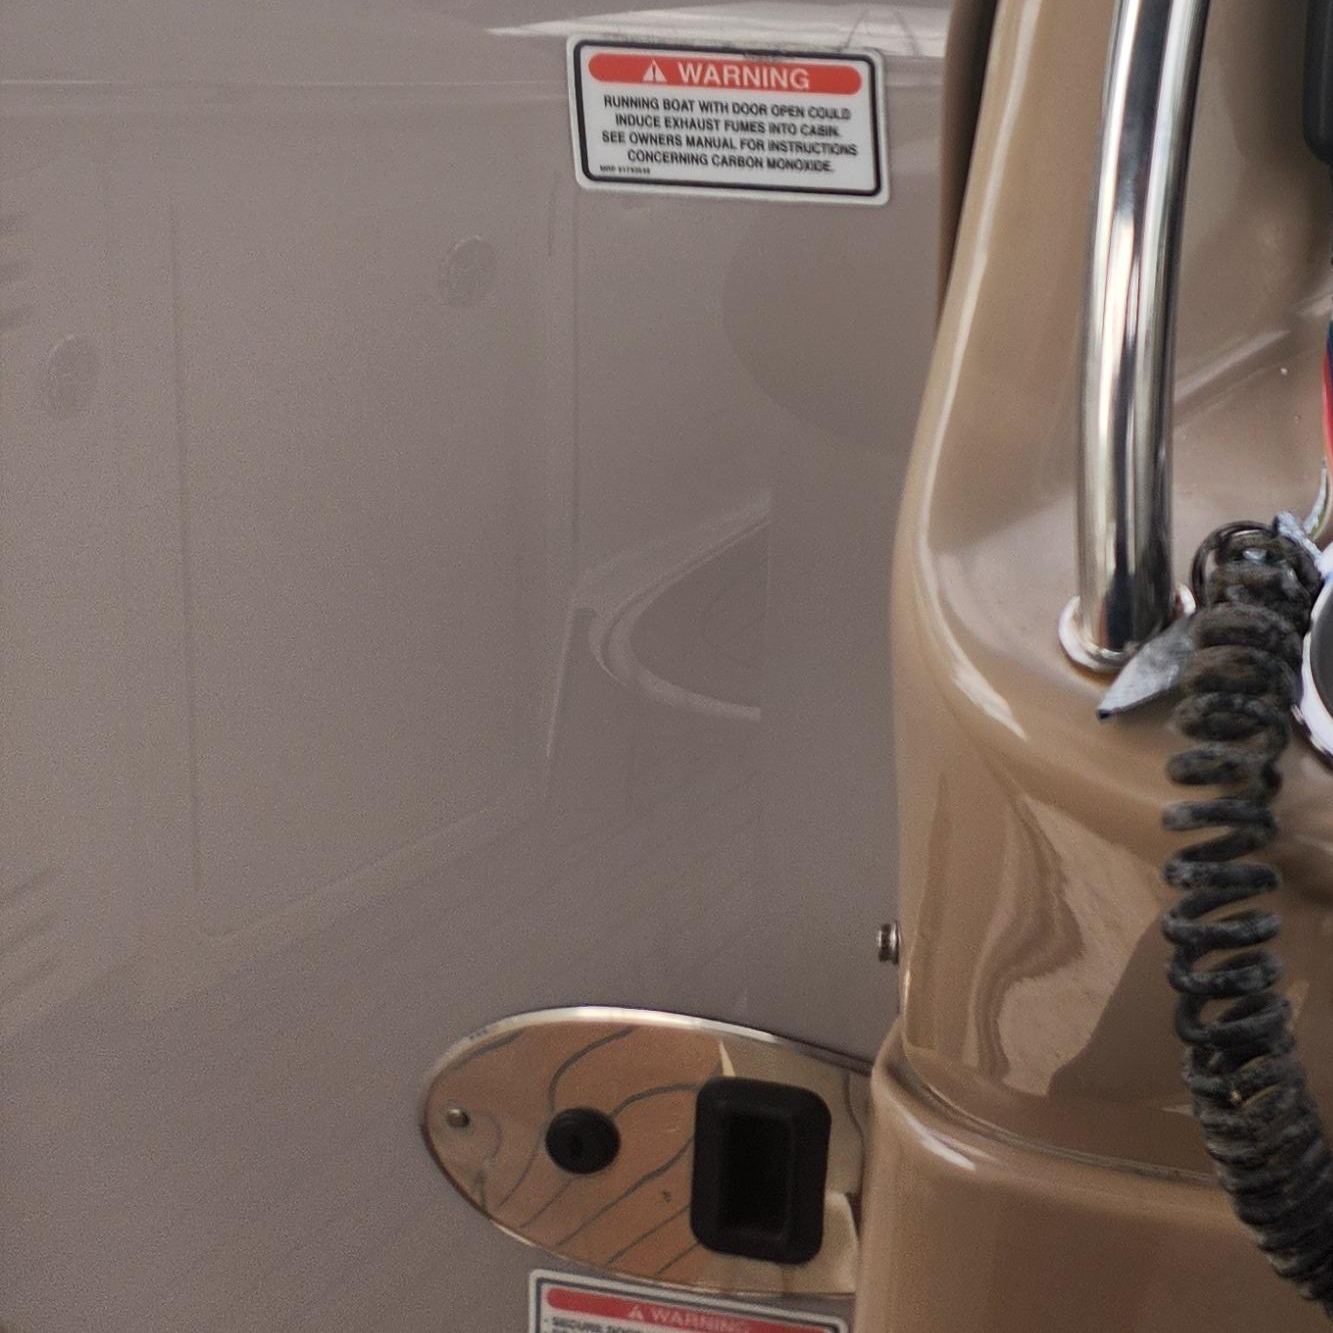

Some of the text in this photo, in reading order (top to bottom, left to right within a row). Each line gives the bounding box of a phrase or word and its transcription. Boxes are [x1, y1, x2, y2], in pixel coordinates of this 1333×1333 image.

[677, 62, 810, 90] WARNING
[603, 95, 852, 121] RUNNING BOAT WITH DOOR OPEN COULD
[615, 112, 662, 128] INDUCE
[664, 115, 721, 131] EXHAUST
[724, 119, 766, 134] FUMES
[768, 122, 797, 136] INTO
[601, 130, 858, 156] SEE OWNERS MANUAL FOR INSTRUCTIONS
[627, 148, 708, 166] CONCERNING
[711, 153, 764, 170] CARBON
